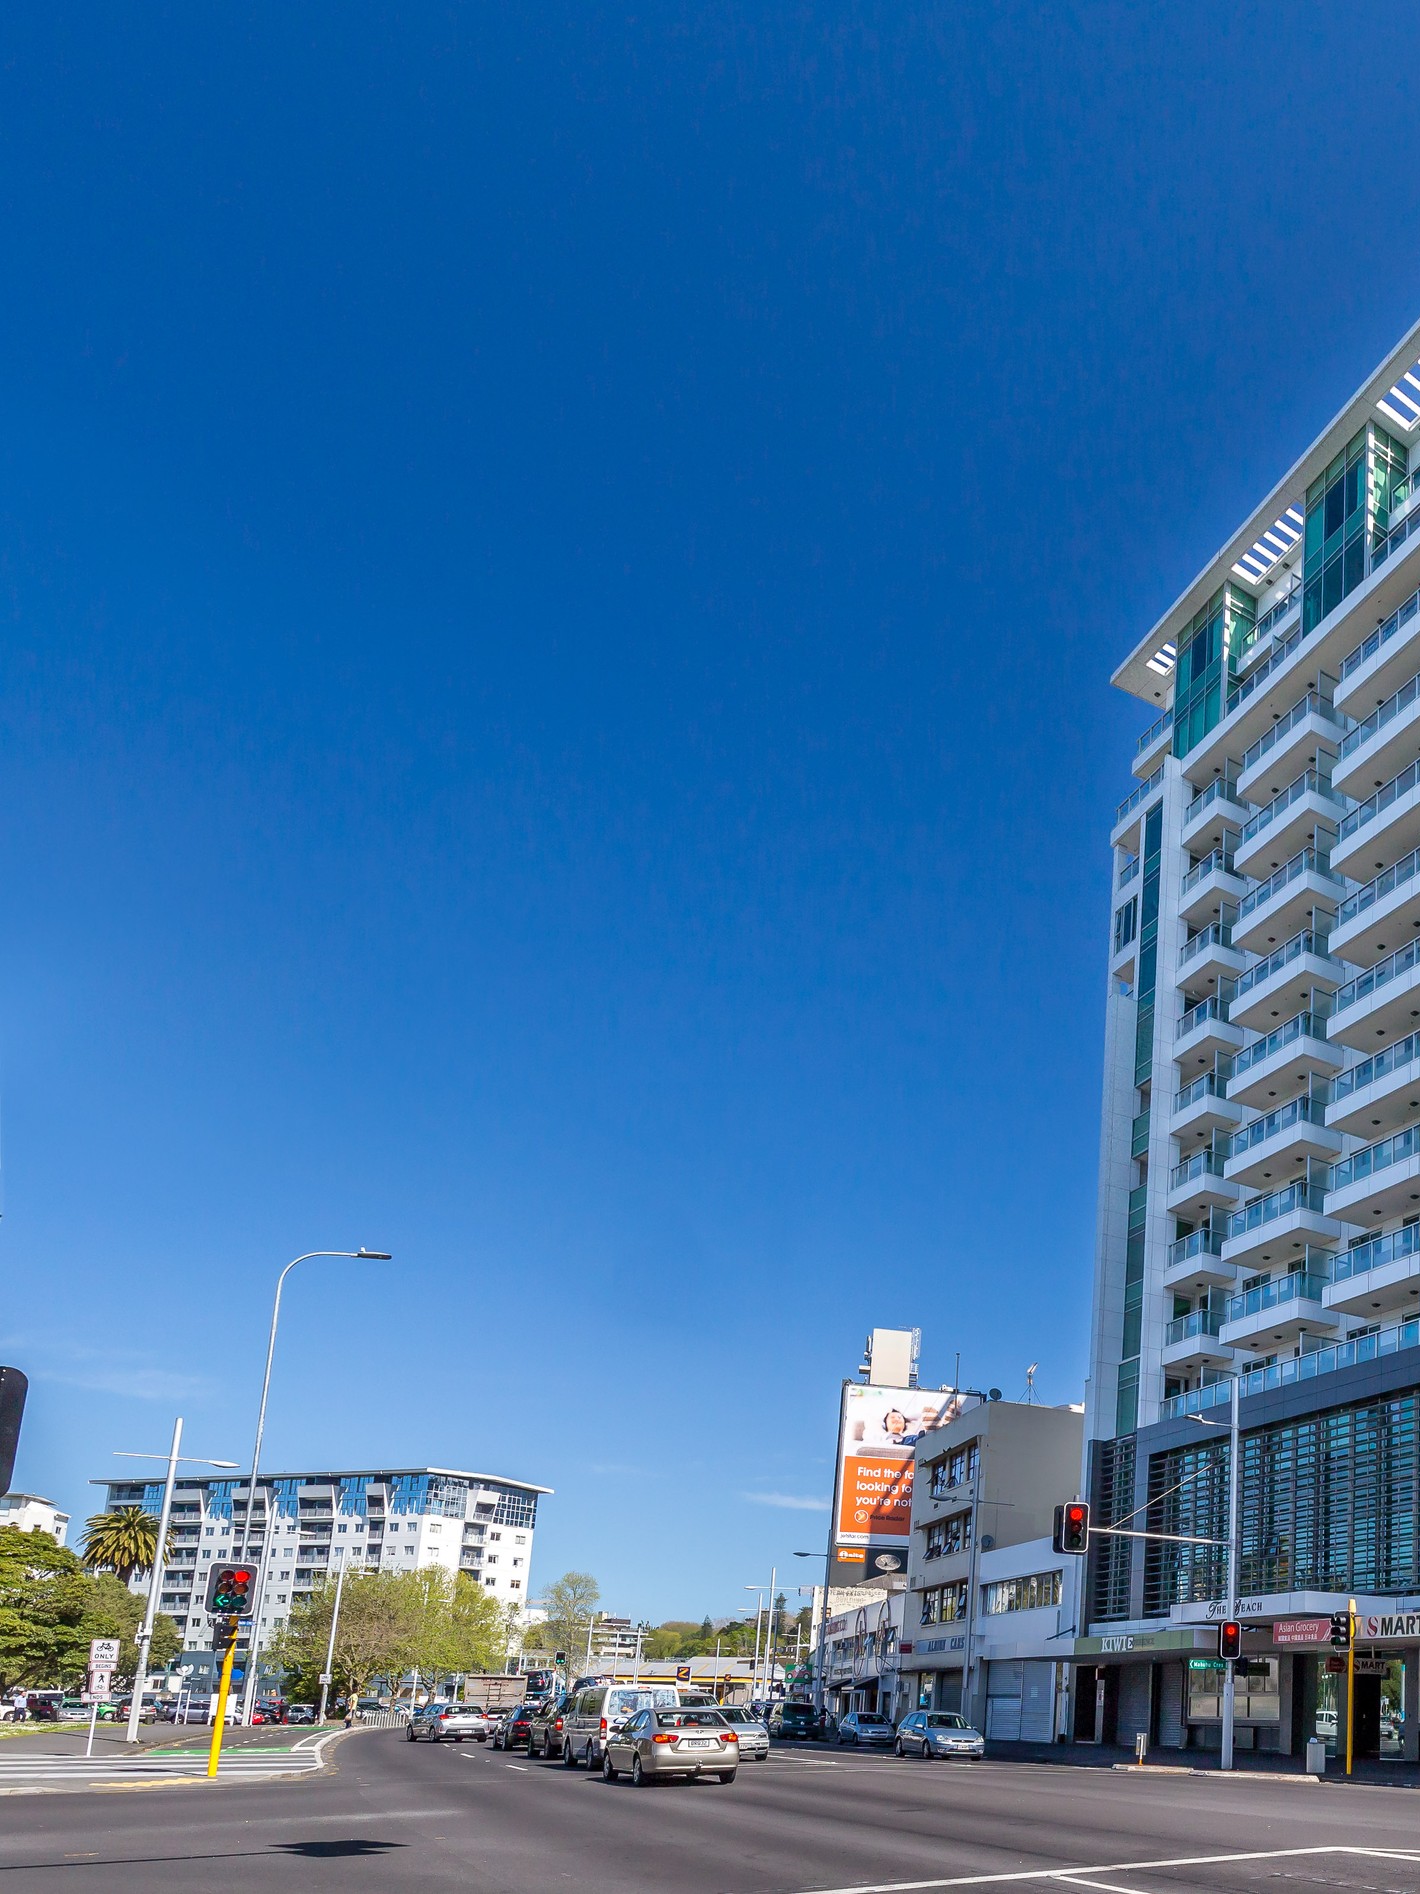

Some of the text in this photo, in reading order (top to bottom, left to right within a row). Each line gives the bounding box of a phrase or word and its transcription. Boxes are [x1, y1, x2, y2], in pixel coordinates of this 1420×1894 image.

[857, 1466, 881, 1479] Find
[883, 1467, 902, 1480] the
[856, 1480, 899, 1495] looking
[855, 1495, 892, 1507] you're
[1278, 1621, 1319, 1634] Asian Grocery
[1101, 1636, 1128, 1652] KIWI
